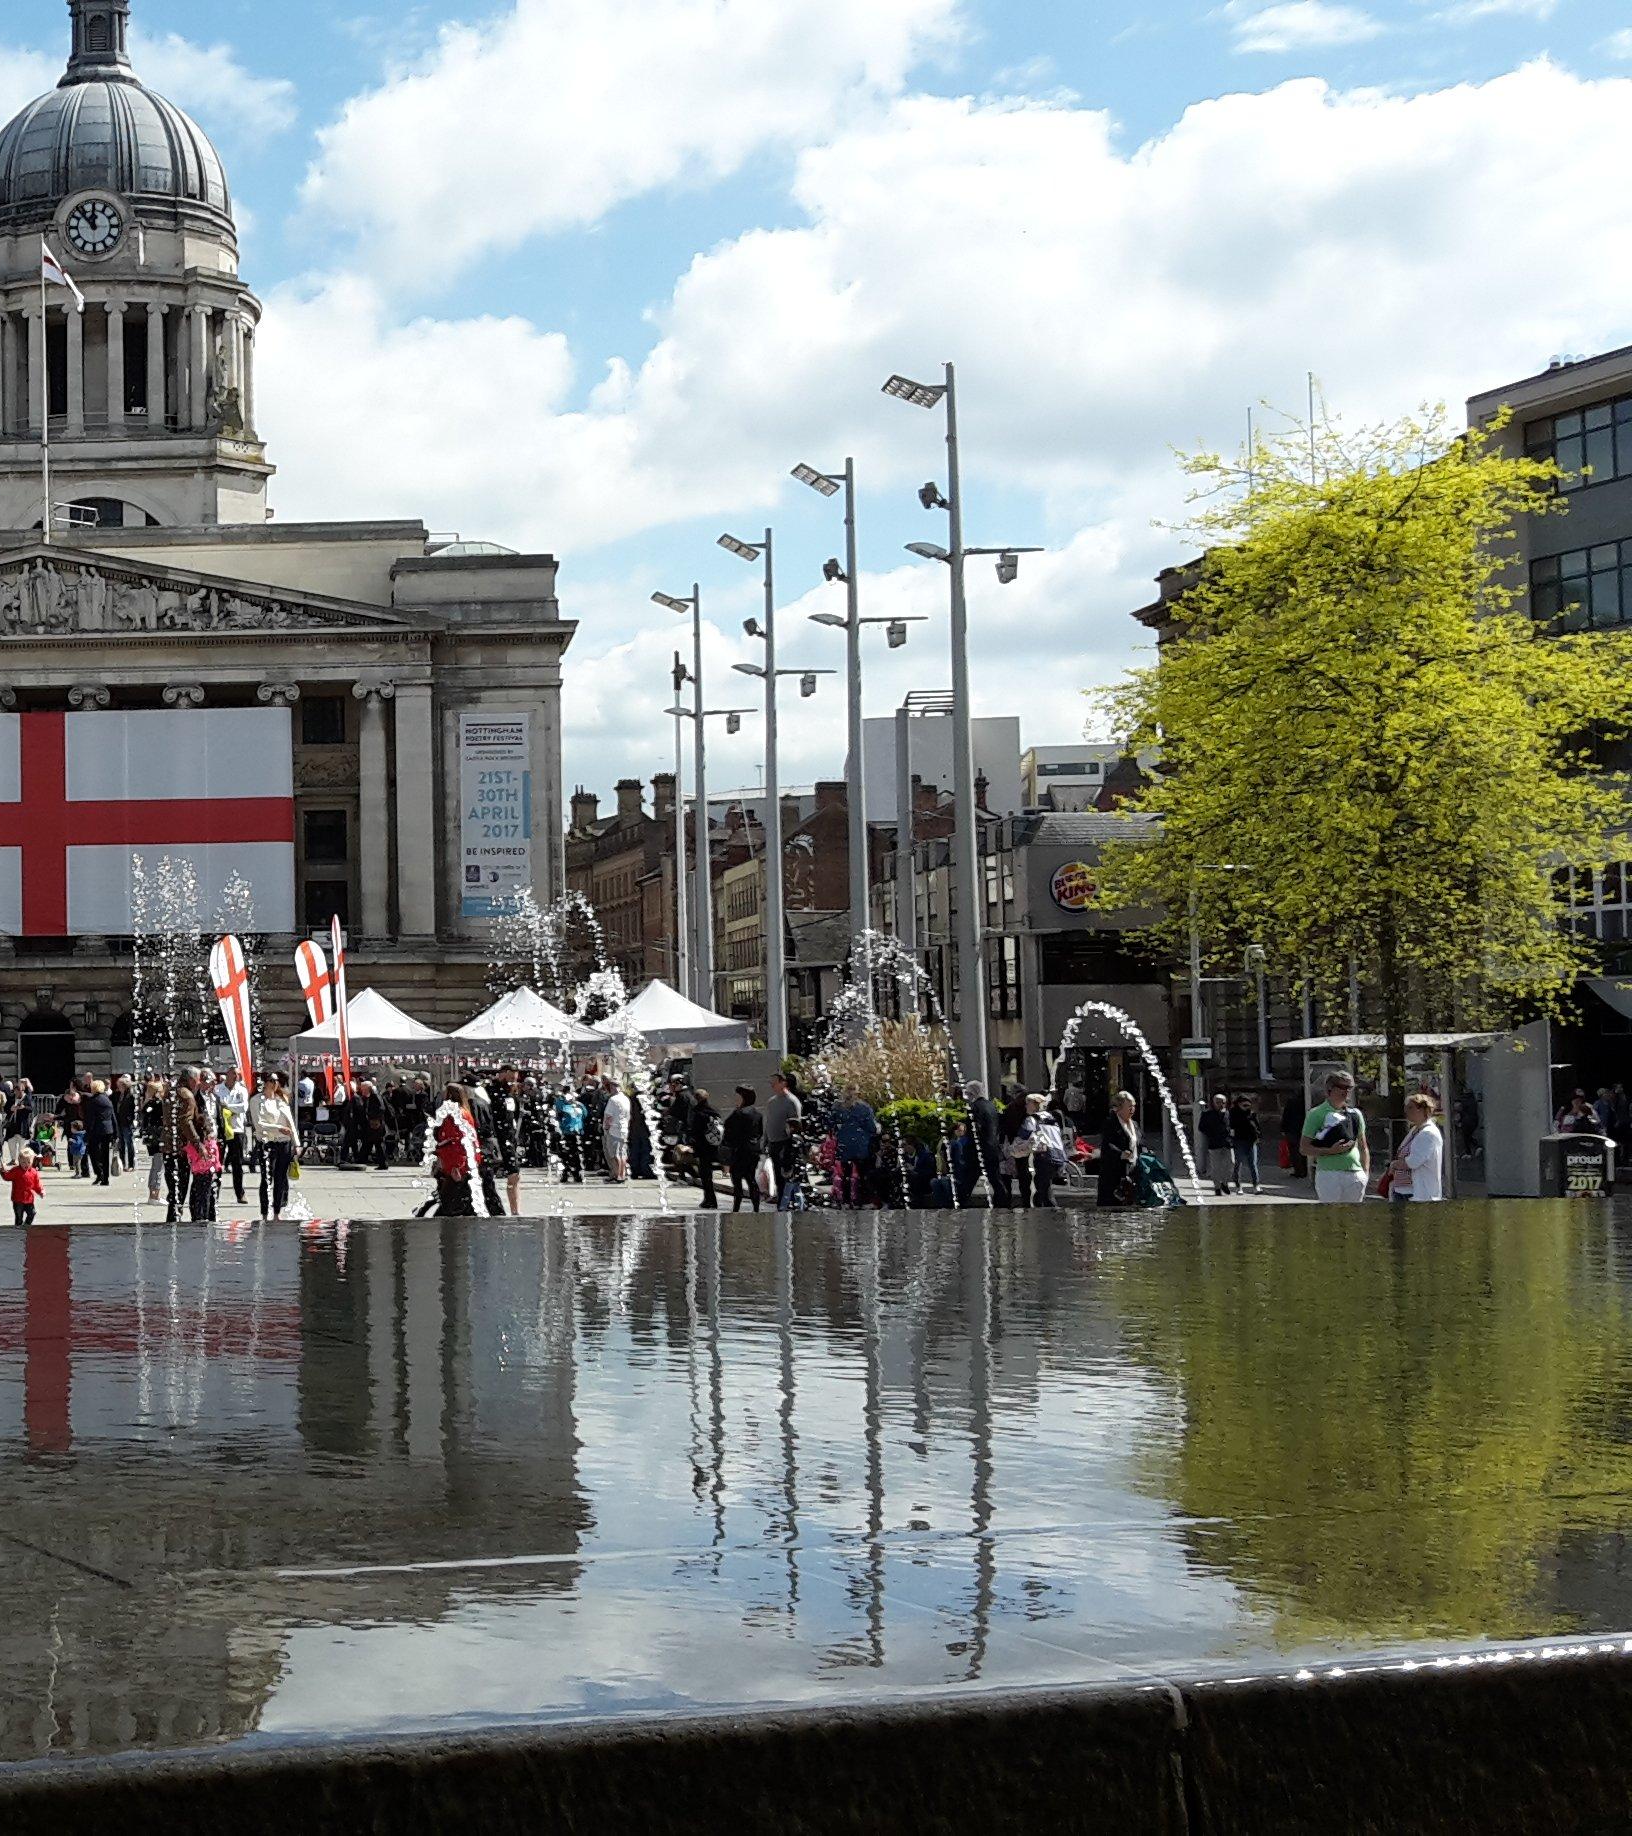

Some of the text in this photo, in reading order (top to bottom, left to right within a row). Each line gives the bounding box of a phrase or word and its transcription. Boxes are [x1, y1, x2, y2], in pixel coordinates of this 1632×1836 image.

[478, 771, 518, 784] 21ST-
[477, 788, 519, 802] 30TH
[468, 806, 519, 820] APRIL
[482, 824, 519, 838] 2017
[480, 847, 526, 855] INSPIRED
[1057, 883, 1097, 904] KING
[1566, 1154, 1603, 1166] proud
[1567, 1176, 1603, 1190] 2017
